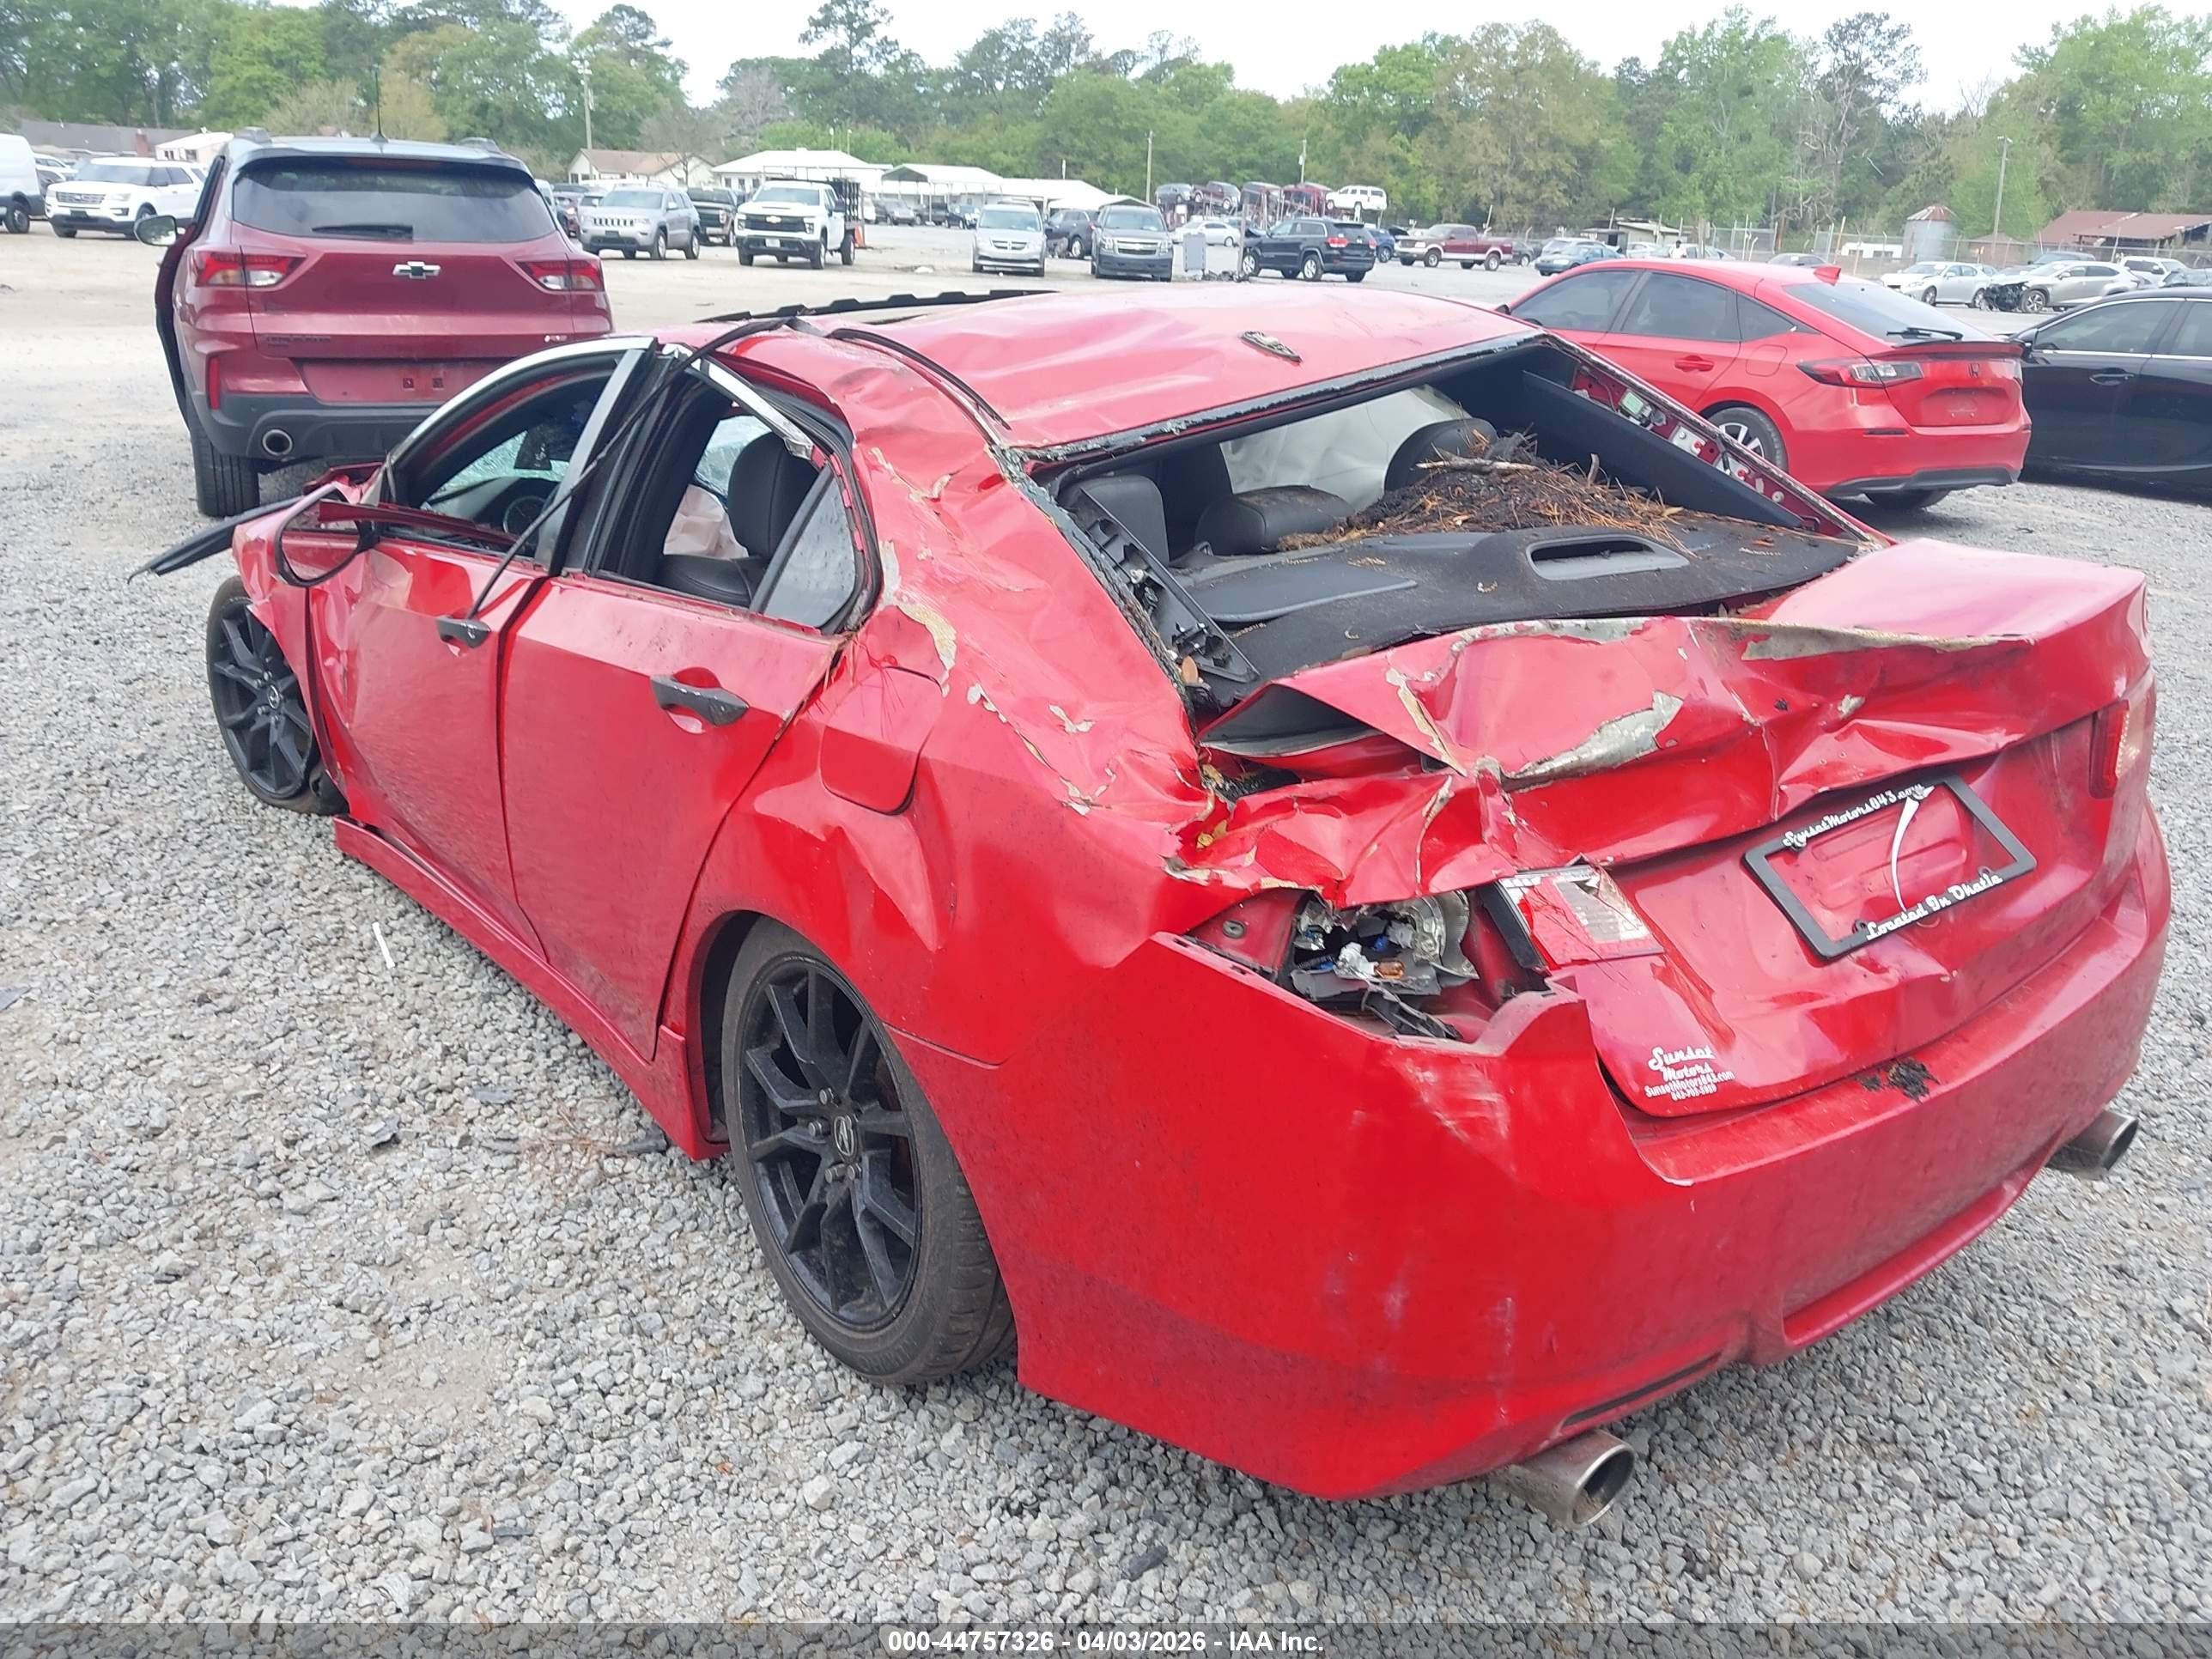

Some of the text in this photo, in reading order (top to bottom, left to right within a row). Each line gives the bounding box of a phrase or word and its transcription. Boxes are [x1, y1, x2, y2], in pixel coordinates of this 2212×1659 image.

[1866, 902, 1929, 940] Located
[1925, 895, 1952, 911] In
[1648, 1045, 1716, 1071] Sunset
[1662, 1062, 1714, 1082] Motors
